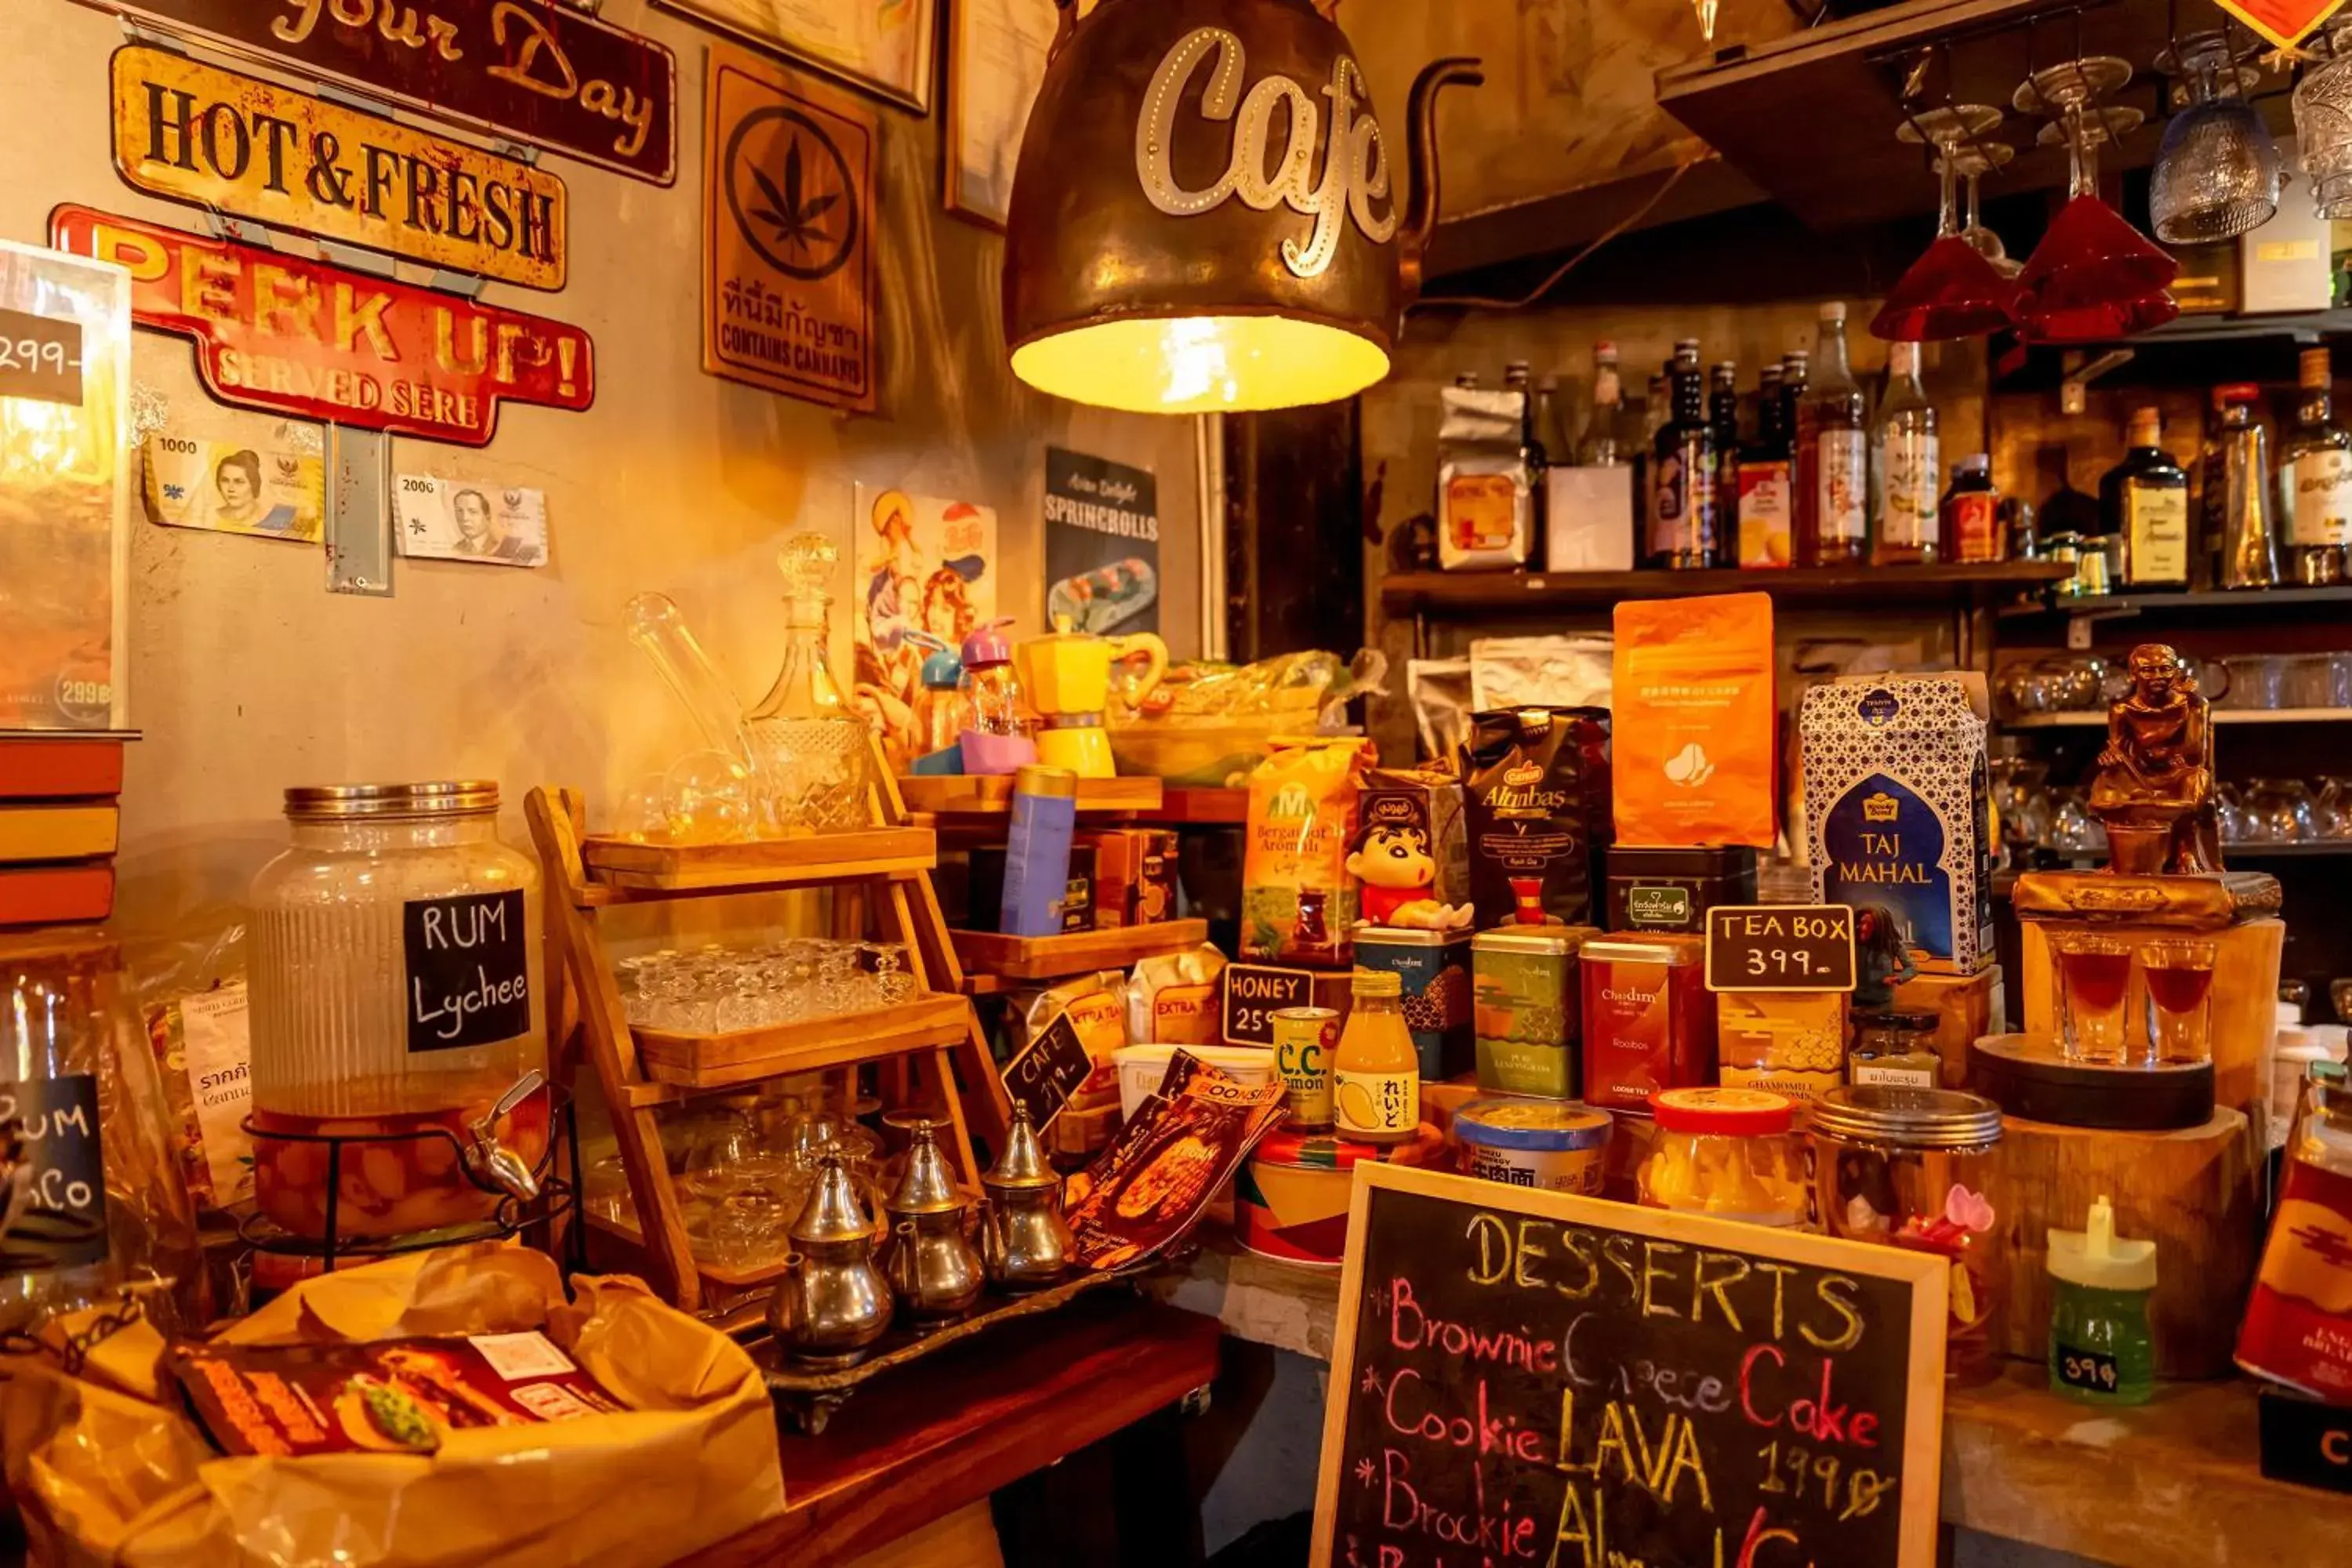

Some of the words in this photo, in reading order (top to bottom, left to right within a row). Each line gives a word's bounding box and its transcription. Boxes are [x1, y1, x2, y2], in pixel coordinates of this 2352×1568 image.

[487, 2, 652, 157] Day
[142, 81, 297, 194] HOT
[307, 130, 355, 210] &
[360, 142, 557, 267] FRESH
[93, 223, 401, 362] PERK
[434, 305, 578, 399] UP!
[218, 349, 383, 412] SERVED
[720, 322, 791, 368] CONTAINS
[794, 343, 862, 387] CANNABIS
[158, 437, 198, 456] 1000
[1045, 492, 1159, 543] SPRINGROLLS
[1839, 861, 1933, 884] MAHAL
[1857, 833, 1901, 859] TAJ
[423, 899, 506, 950] RUM
[1719, 915, 1785, 939] TEA
[1793, 916, 1850, 940] BOX
[414, 964, 526, 1040] Lychee
[1157, 1000, 1199, 1015] EXTRA
[1230, 976, 1299, 1000] HONEY
[1022, 1026, 1065, 1084] CAFE
[1278, 1043, 1327, 1076] C.C.
[1466, 1212, 1866, 1351] DESSERTS
[1389, 1277, 1557, 1374] Brownie
[1739, 1343, 1879, 1448] Cake
[1385, 1368, 1544, 1463] Cookie
[1555, 1387, 1714, 1512] LAVA
